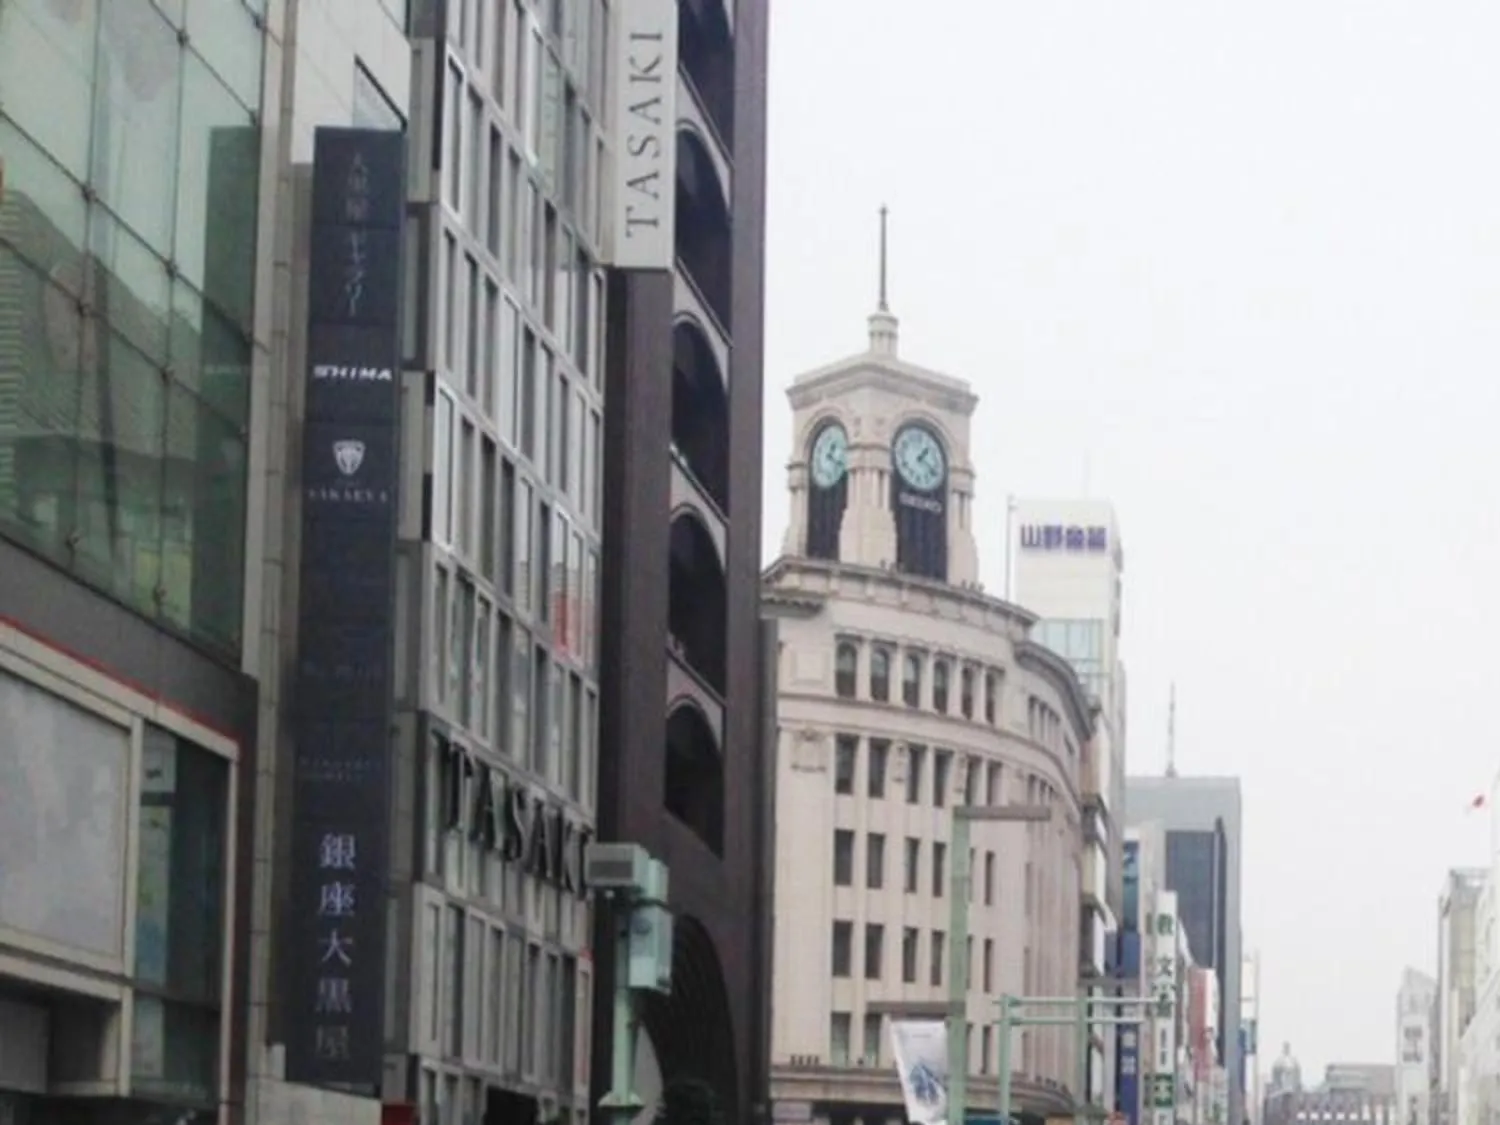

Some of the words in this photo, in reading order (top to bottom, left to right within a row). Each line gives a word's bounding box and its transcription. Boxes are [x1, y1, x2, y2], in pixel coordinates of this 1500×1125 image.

[626, 32, 663, 239] TASAKI
[432, 728, 593, 901] TASAKI
[315, 832, 355, 1060] 銀座大黒屋
